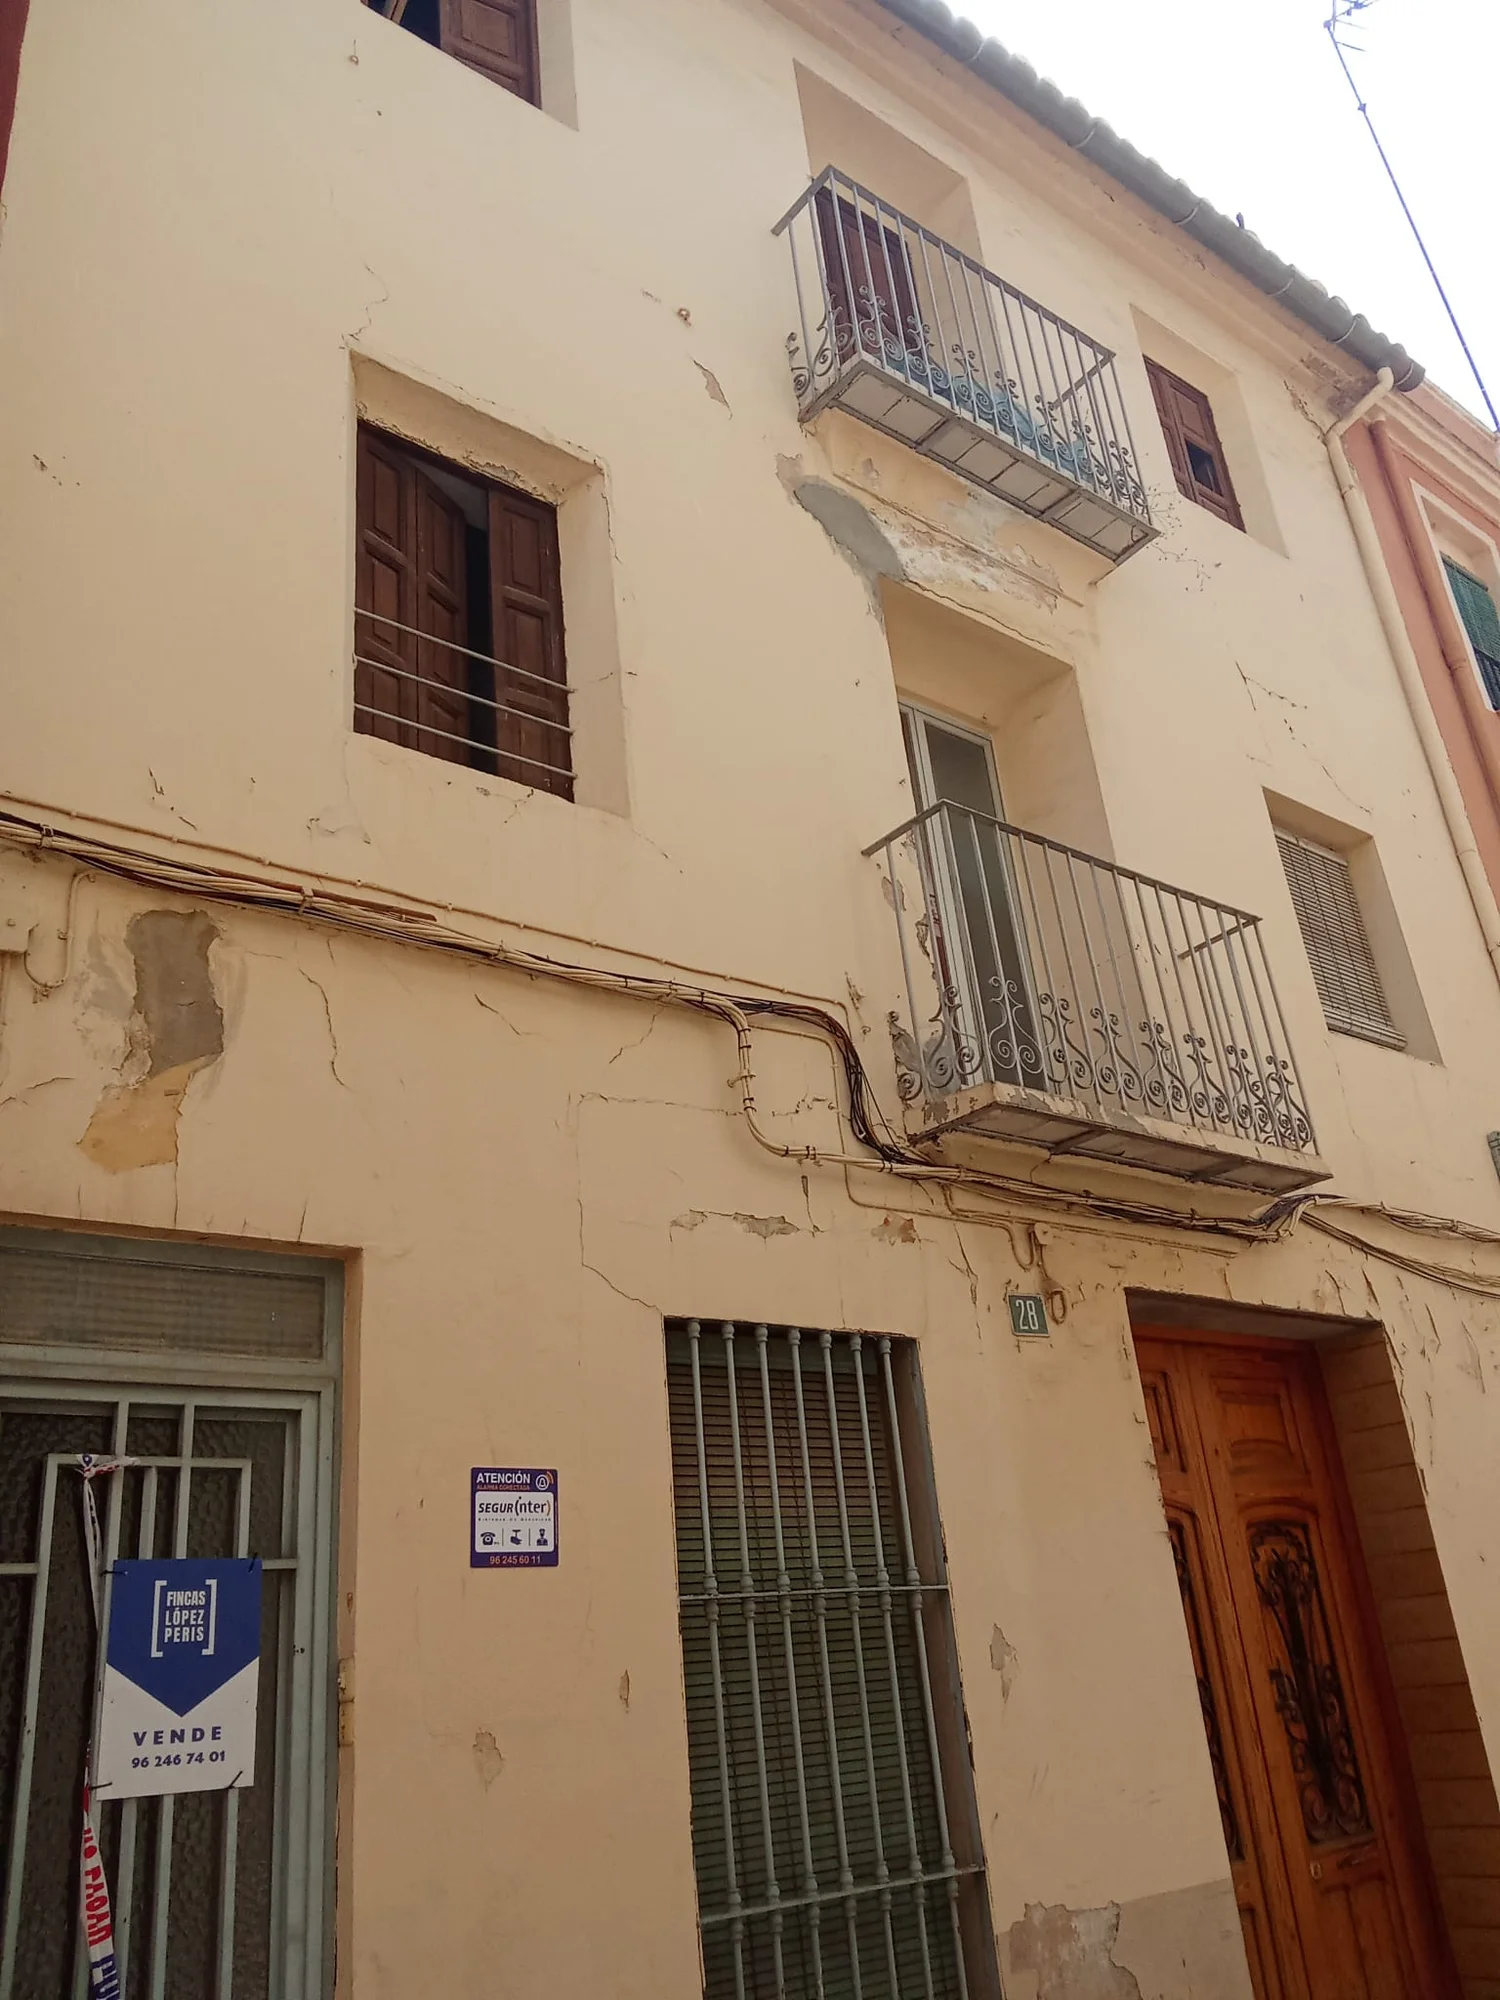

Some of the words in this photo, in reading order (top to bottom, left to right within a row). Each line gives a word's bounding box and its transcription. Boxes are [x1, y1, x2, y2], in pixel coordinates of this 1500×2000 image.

[1016, 1300, 1038, 1329] 28
[476, 1471, 531, 1484] ATENCIÓN
[489, 1556, 501, 1564] 96
[502, 1556, 517, 1564] 245
[519, 1556, 529, 1564] 60
[531, 1555, 540, 1564] 11
[166, 1591, 206, 1606] FINCAS
[165, 1607, 205, 1626] LÓPEZ
[164, 1626, 204, 1643] PERIS
[133, 1726, 221, 1746] VENDE
[131, 1757, 149, 1768] 96
[154, 1754, 181, 1767] 246
[186, 1752, 204, 1764] 74
[209, 1750, 225, 1762] 01
